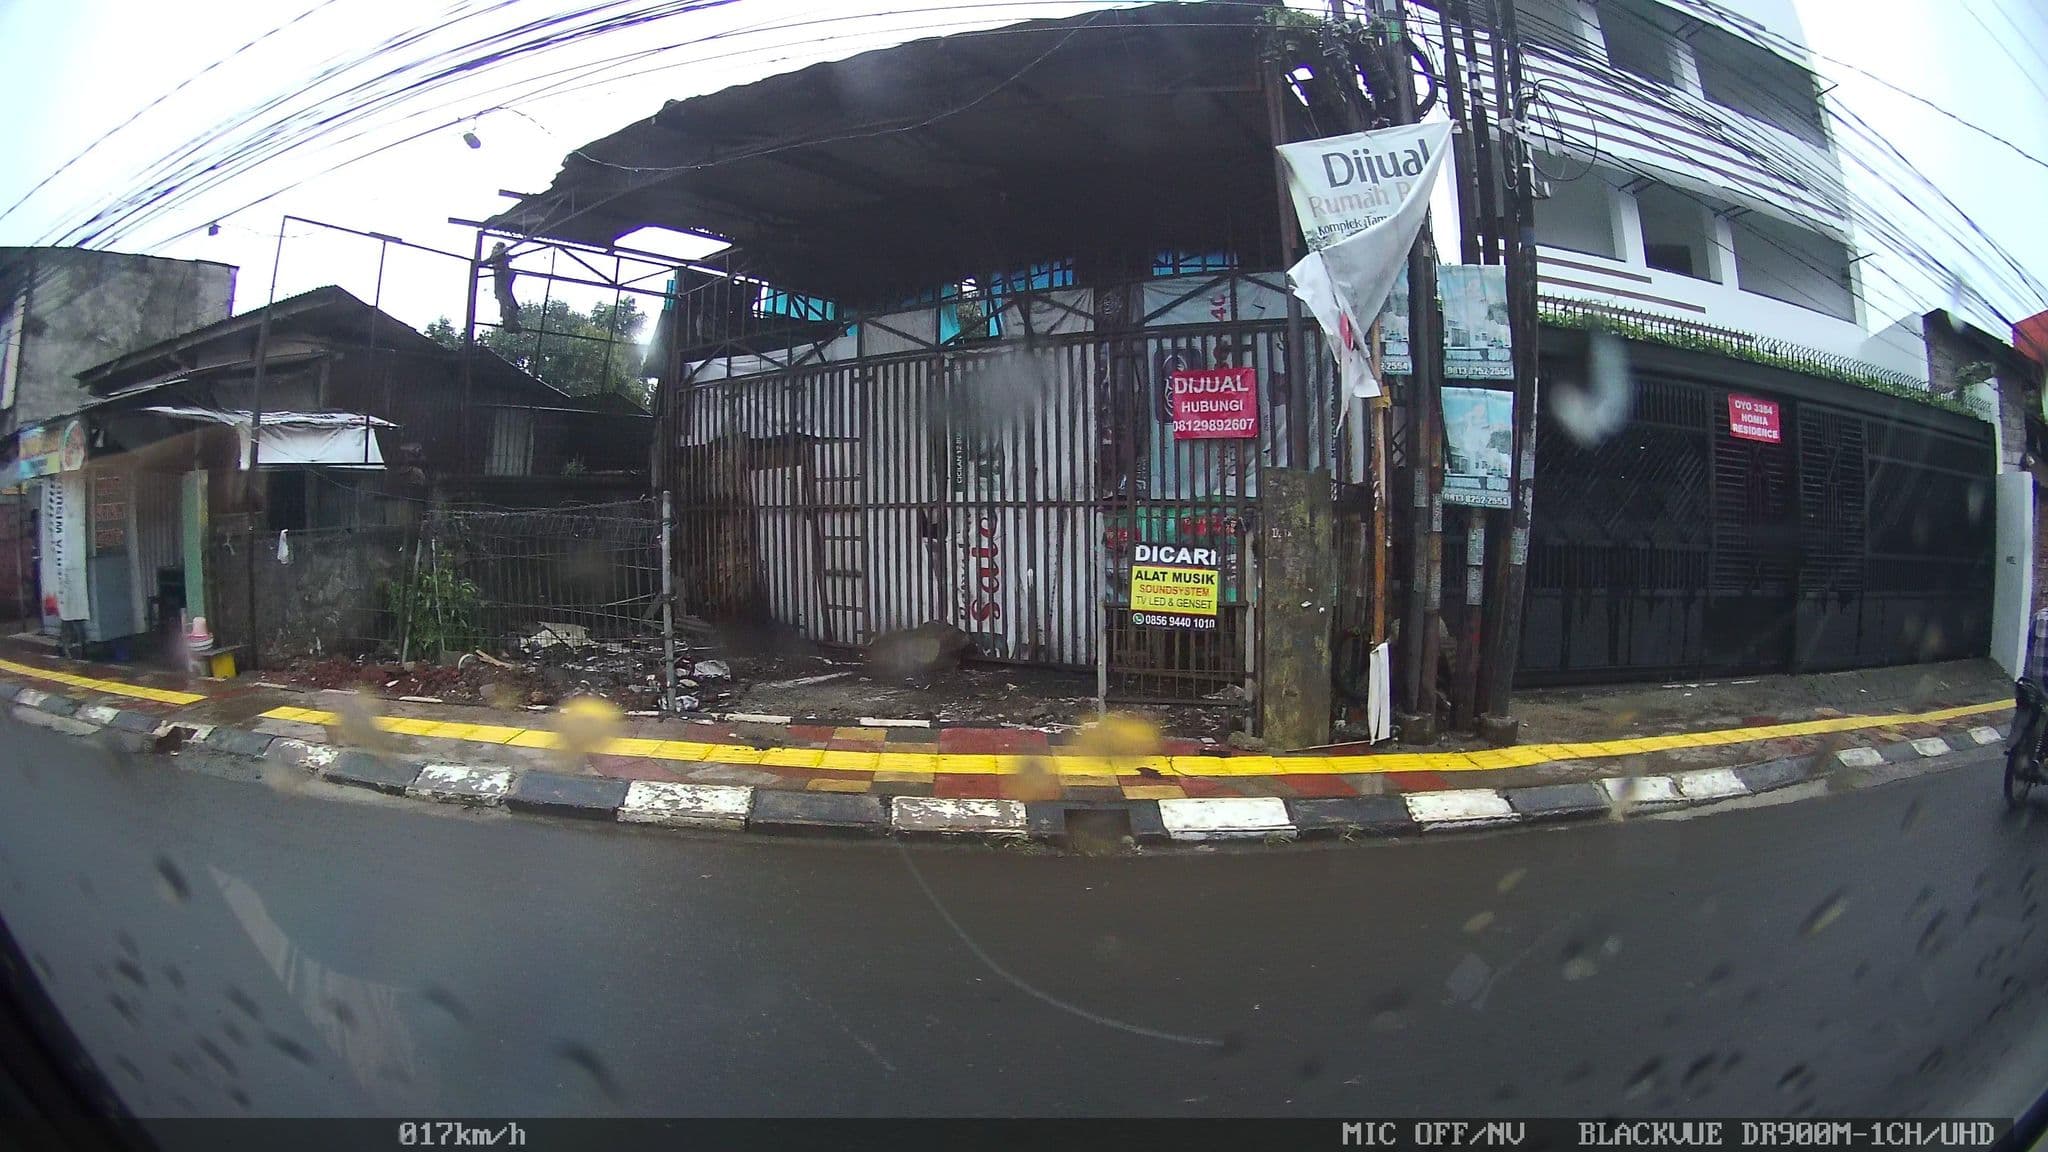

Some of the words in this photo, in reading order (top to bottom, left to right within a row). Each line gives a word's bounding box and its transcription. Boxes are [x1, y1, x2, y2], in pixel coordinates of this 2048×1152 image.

[1321, 139, 1430, 189] Dijual
[1308, 186, 1390, 219] Rumah
[1317, 217, 1363, 237] Komplek
[1174, 375, 1249, 394] DIJUAL
[1181, 399, 1243, 413] HUBUNGI
[1734, 399, 1752, 410] OYO
[1173, 418, 1254, 432] 08129892607
[1741, 413, 1769, 426] HOMIA
[1732, 423, 1779, 439] RESIDENCE
[1135, 544, 1217, 566] DICARI
[1135, 569, 1168, 582] ALAT
[1172, 572, 1215, 585] MUSIK
[1139, 583, 1210, 597] SOUNDSYSTEM
[1136, 595, 1147, 606] TV
[1149, 596, 1166, 607] LED
[1168, 597, 1174, 607] &
[1176, 598, 1213, 609] GENSET
[1145, 614, 1167, 626] 0856
[1169, 615, 1191, 628] 9440
[1193, 617, 1215, 629] 1010
